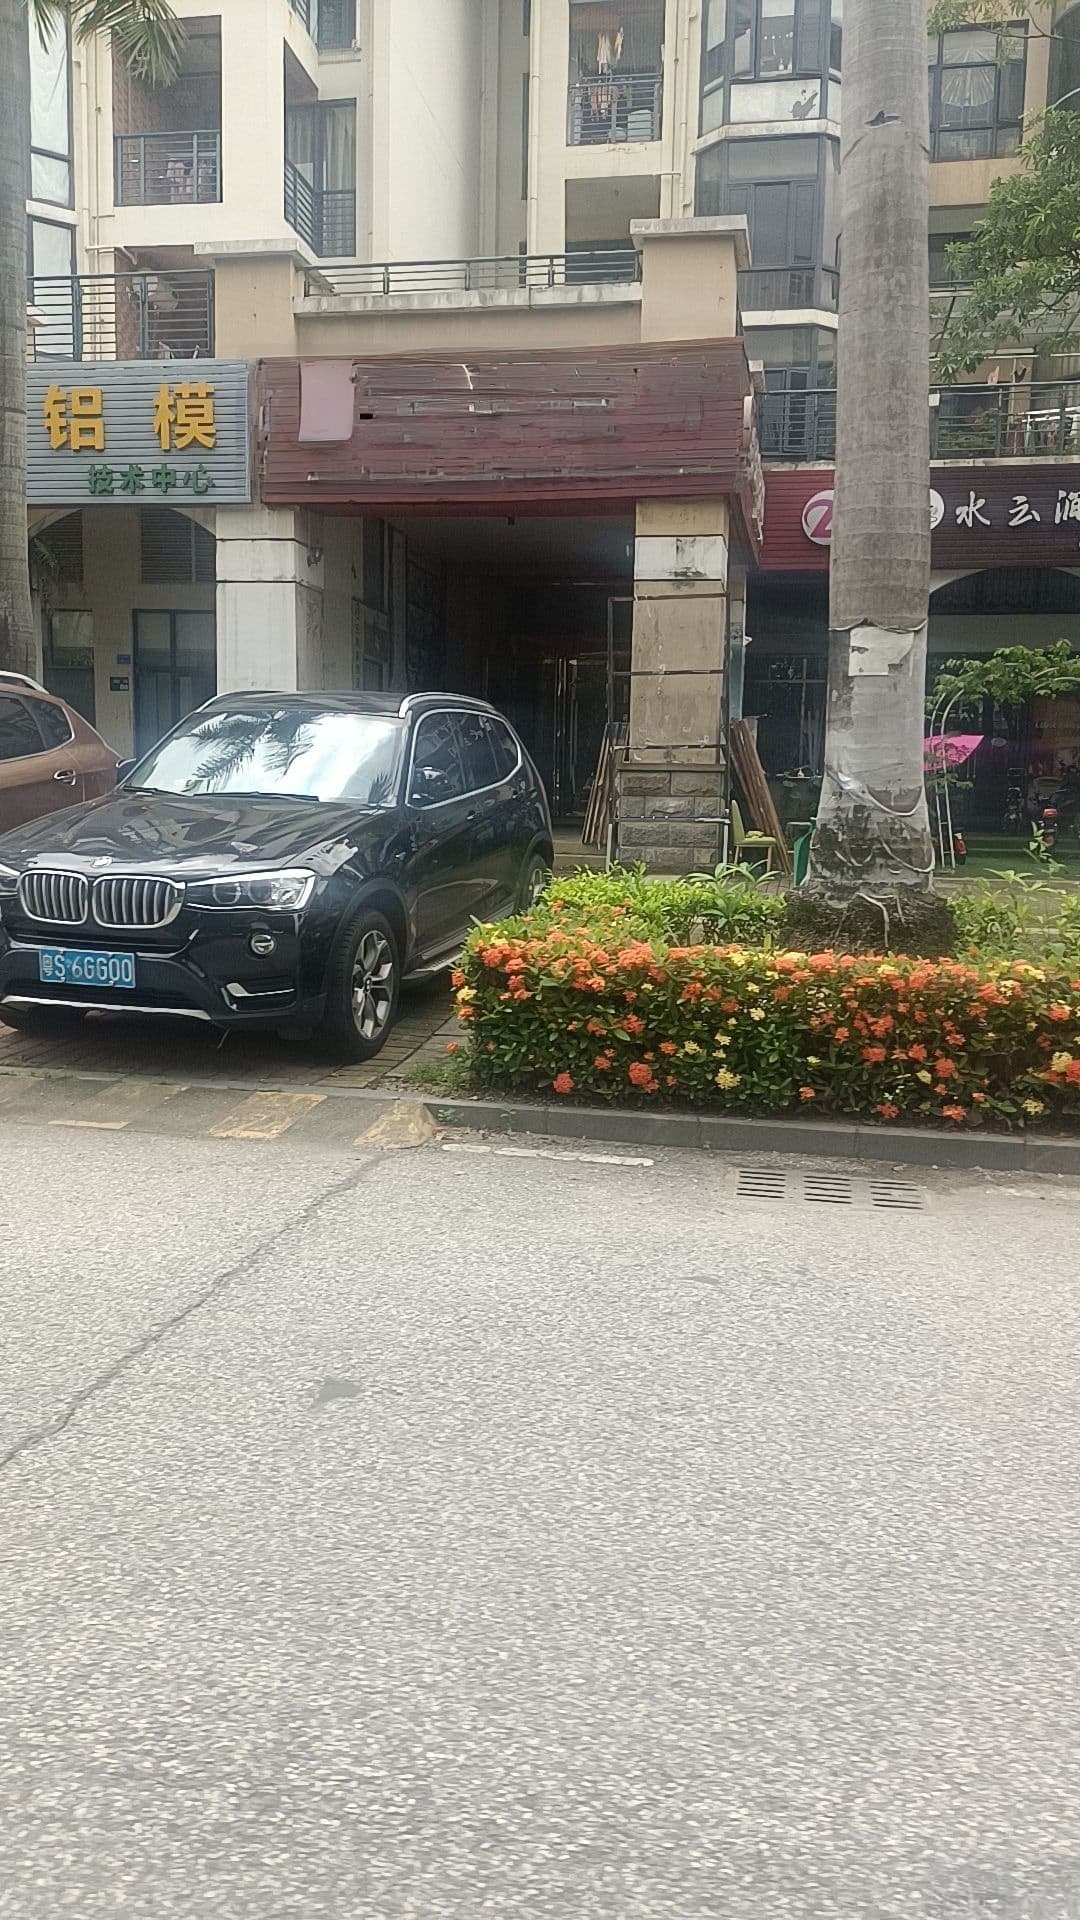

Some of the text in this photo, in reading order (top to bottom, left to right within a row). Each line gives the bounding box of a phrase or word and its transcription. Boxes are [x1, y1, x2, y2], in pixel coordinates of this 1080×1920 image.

[43, 383, 216, 452] 铝模
[88, 463, 215, 494] 技术中心
